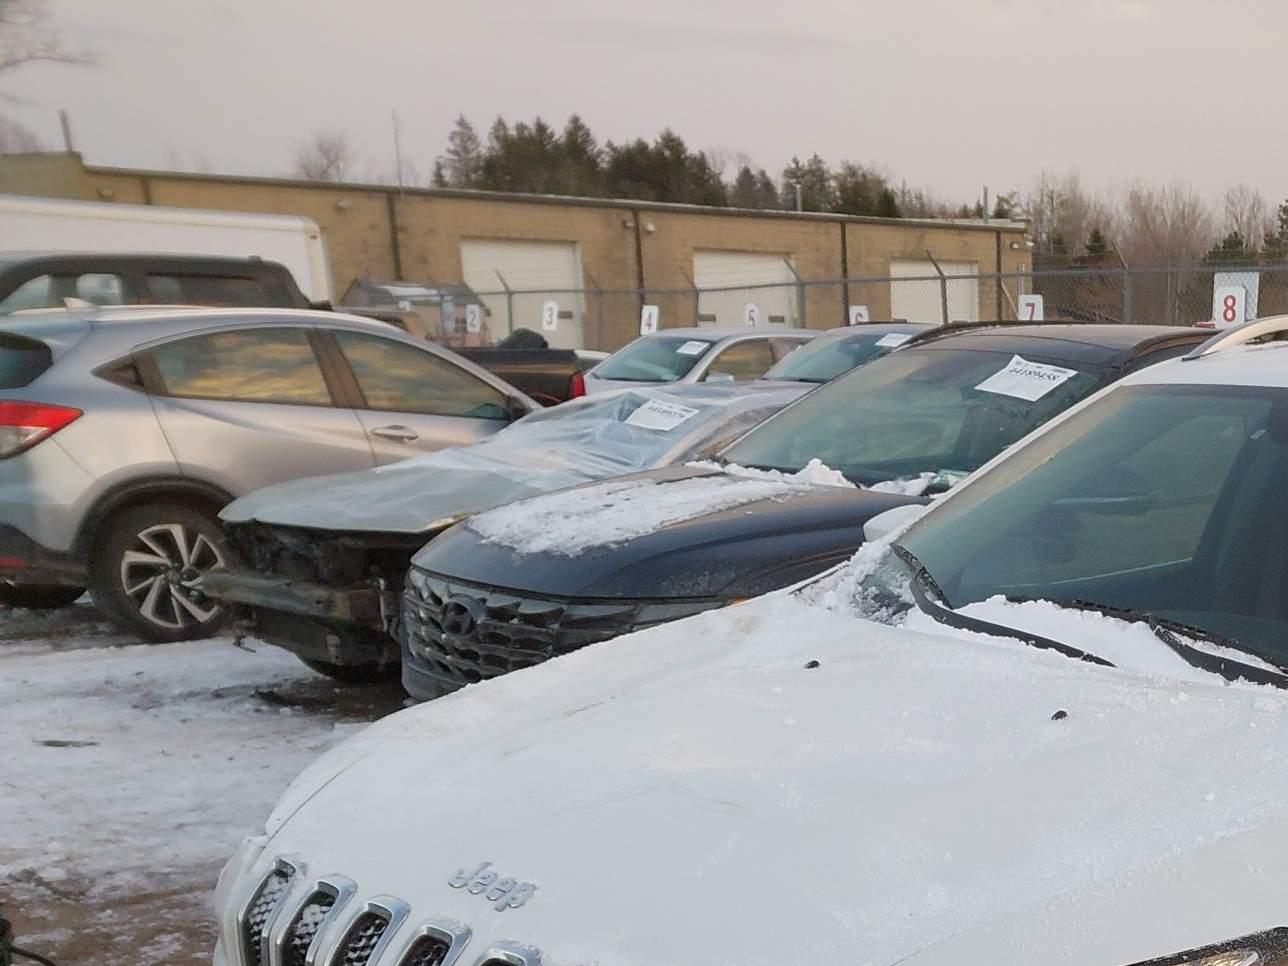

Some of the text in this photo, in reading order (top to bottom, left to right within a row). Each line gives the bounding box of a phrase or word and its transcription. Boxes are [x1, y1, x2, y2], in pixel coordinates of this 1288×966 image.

[546, 307, 556, 325] 3
[1025, 302, 1036, 321] 7
[1222, 294, 1237, 323] 8
[645, 311, 654, 331] 4
[447, 861, 538, 913] Jeep
